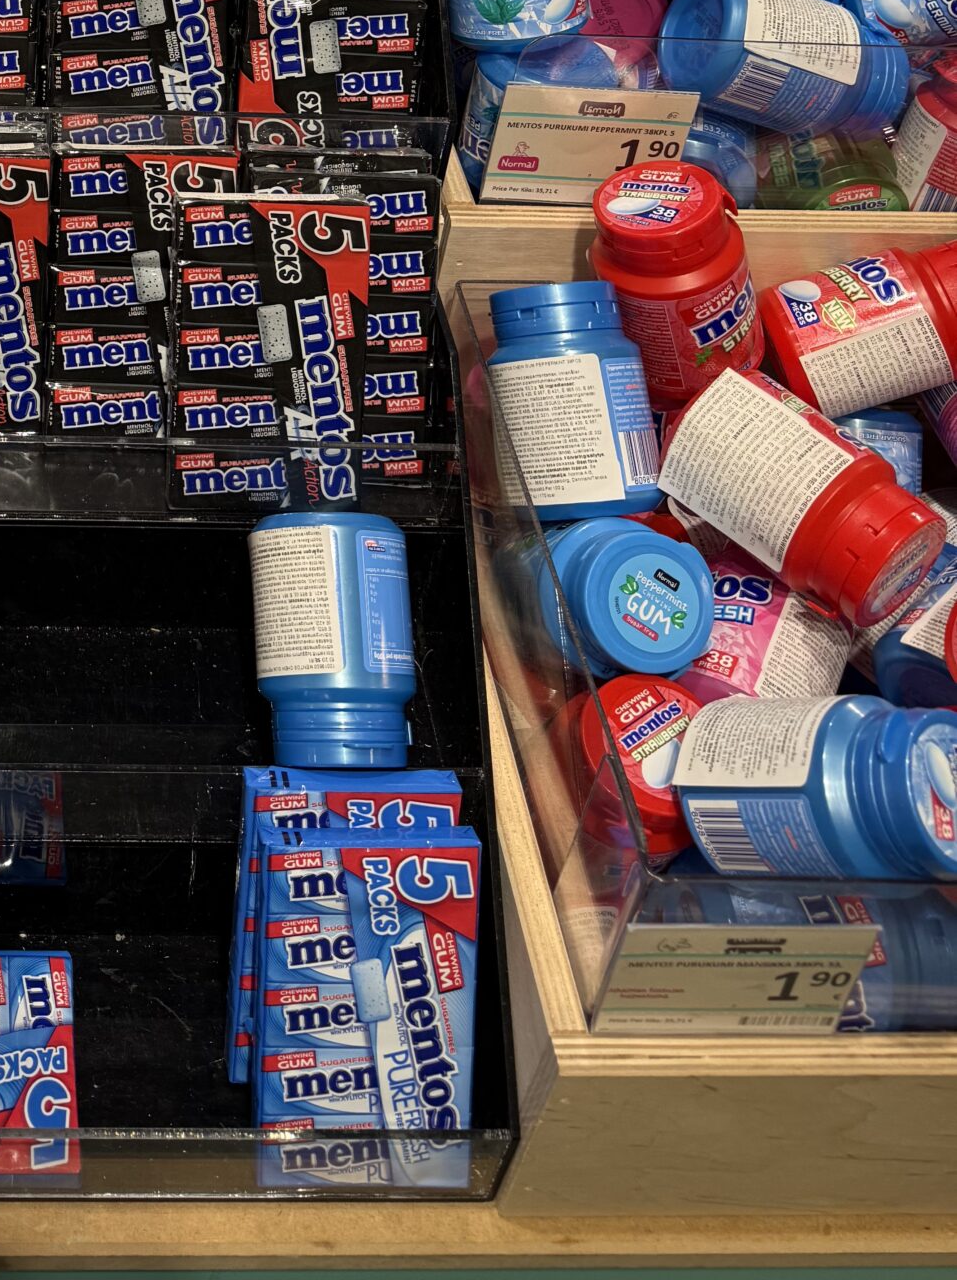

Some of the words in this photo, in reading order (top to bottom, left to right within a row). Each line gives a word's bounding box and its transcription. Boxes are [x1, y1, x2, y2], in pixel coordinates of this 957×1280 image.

[506, 121, 542, 130] MENTOS
[543, 123, 589, 132] PURUKUMI
[590, 125, 642, 135] PEPPERMINT
[500, 157, 536, 170] Normal
[642, 169, 682, 177] CHEWING
[622, 181, 691, 195] mentos
[639, 174, 680, 183] GUM
[617, 190, 690, 203] STRAWBERRY
[652, 206, 677, 218] 38
[297, 210, 369, 255] 5
[268, 211, 301, 284] PACKS
[23, 286, 40, 346] SUGARFREE
[294, 296, 358, 500] mentos
[635, 570, 688, 612] Peppermint
[656, 570, 679, 589] Normal
[626, 592, 672, 635] GUM
[698, 658, 732, 677] PIECES
[706, 649, 734, 670] 38
[614, 687, 651, 715] CHEWING
[618, 696, 657, 724] GUM
[621, 701, 683, 751] mentos
[630, 715, 693, 762] STRAWBERRY
[284, 852, 321, 861] CHEWING
[284, 858, 321, 869] GUM
[396, 855, 474, 904] 5
[363, 857, 400, 936] PACKS
[439, 997, 456, 1054] SUGARFREE
